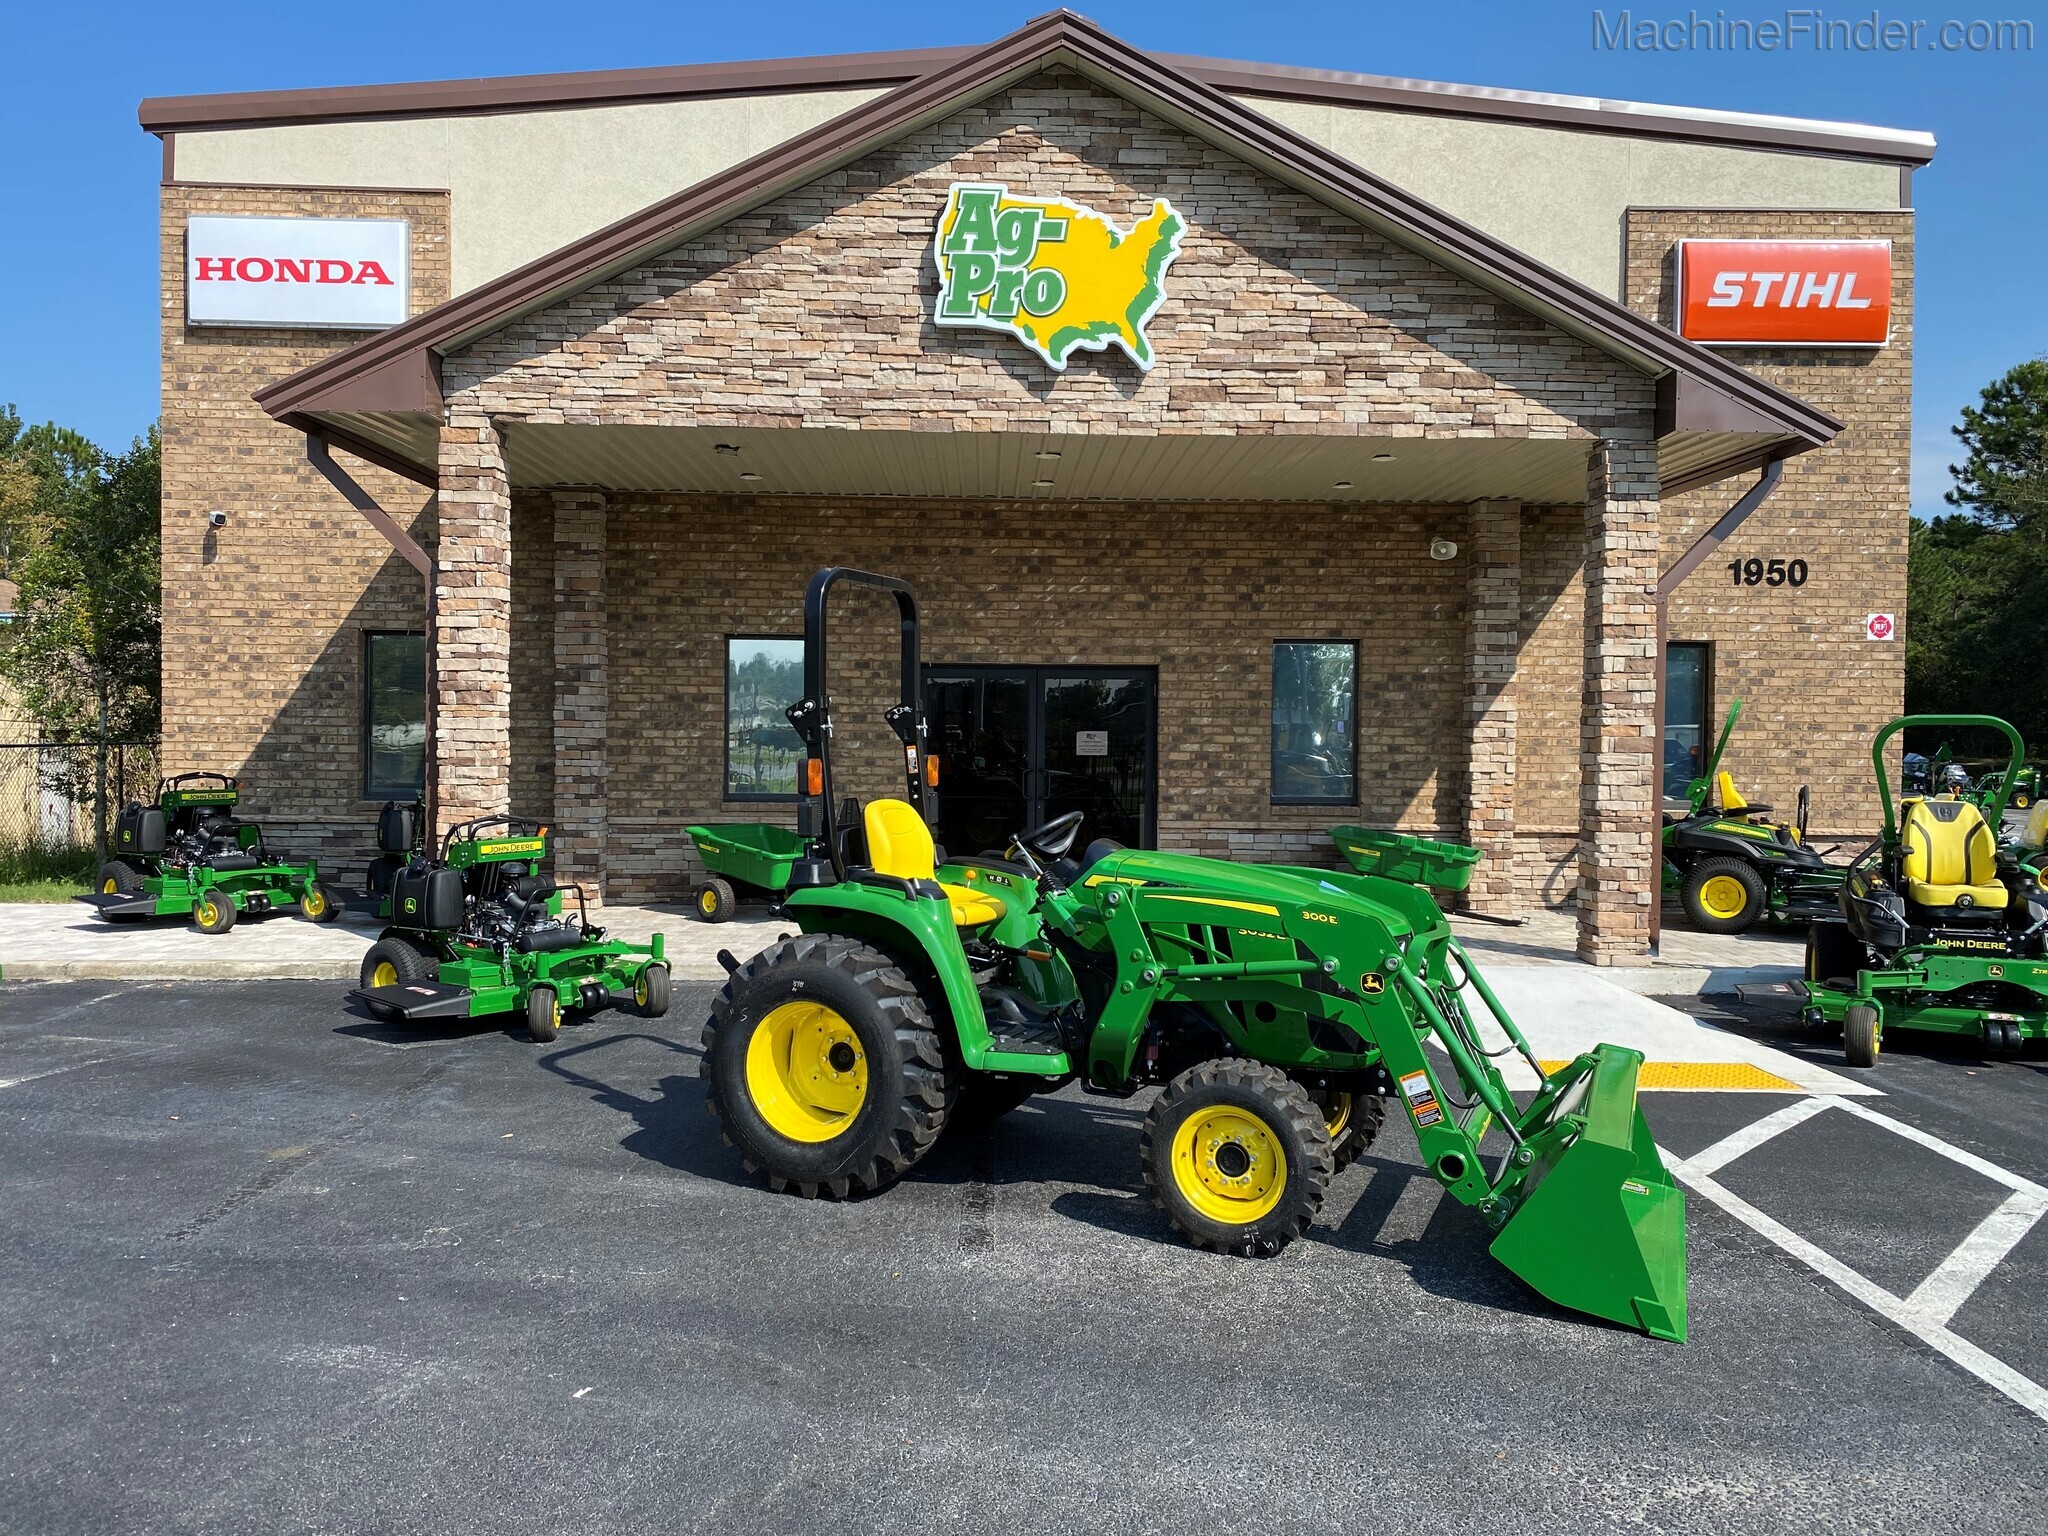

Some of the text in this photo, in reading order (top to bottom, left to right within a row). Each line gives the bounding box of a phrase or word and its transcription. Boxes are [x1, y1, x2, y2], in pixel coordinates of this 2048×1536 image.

[941, 188, 1070, 268] Ag-
[194, 257, 395, 285] HONDA
[940, 254, 1068, 318] Pro
[1706, 271, 1872, 309] STIHL
[1727, 558, 1809, 587] 1950
[1874, 623, 1887, 631] RF
[488, 843, 535, 854] JOHN DEERE
[1932, 938, 2007, 950] JOHN DEERE
